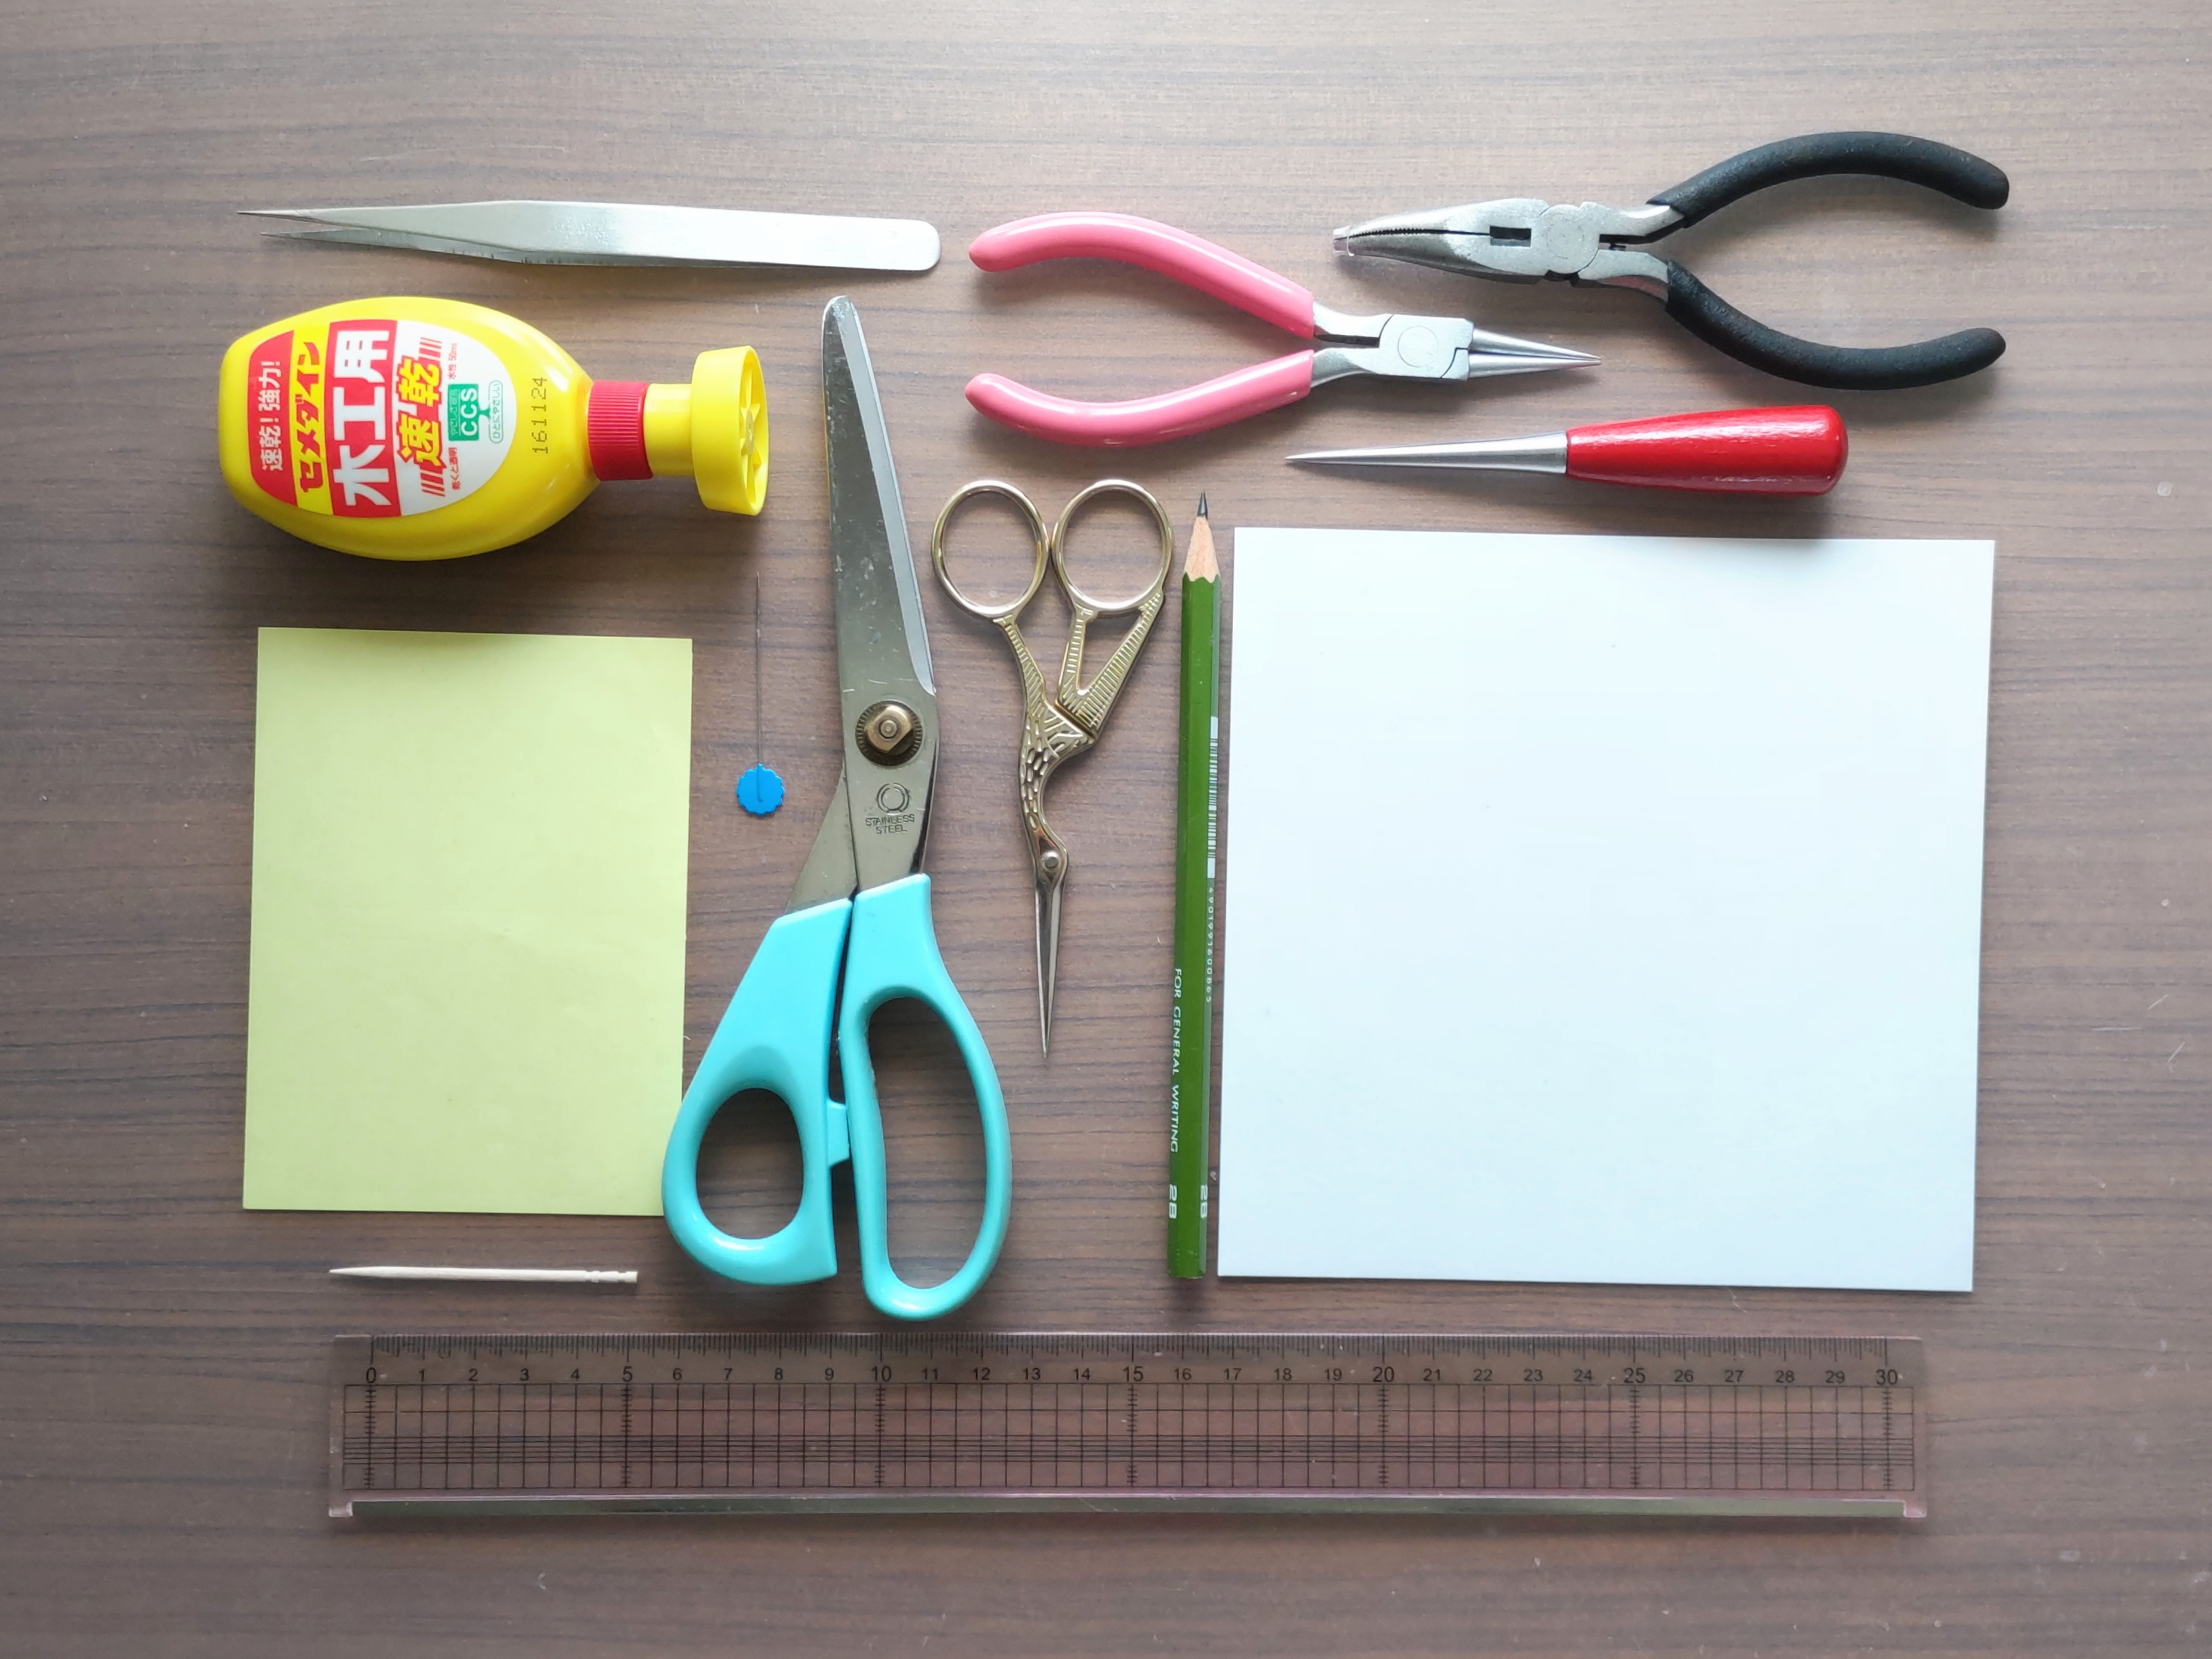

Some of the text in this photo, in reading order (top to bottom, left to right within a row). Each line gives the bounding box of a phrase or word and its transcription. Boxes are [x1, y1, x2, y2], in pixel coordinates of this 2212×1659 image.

[295, 342, 323, 492] セメダイン
[333, 330, 391, 506] 木工用
[398, 358, 443, 467] 速乾
[460, 388, 478, 436] CCS
[492, 383, 501, 439] ひとにやさしい
[865, 814, 915, 827] STAINLESS
[875, 824, 908, 835] STEEL
[1172, 1006, 1181, 1076] GENERAL
[1170, 1084, 1179, 1153] WRITING
[1169, 1183, 1178, 1219] 2B
[1200, 1184, 1208, 1219] 2B
[366, 1365, 1898, 1385] 0 1 2 3 4 5 6 7 8 9 10 11 12 13 14 15 16 17 18 19 20 21 22 23 24 25 26 27 28 29 30
